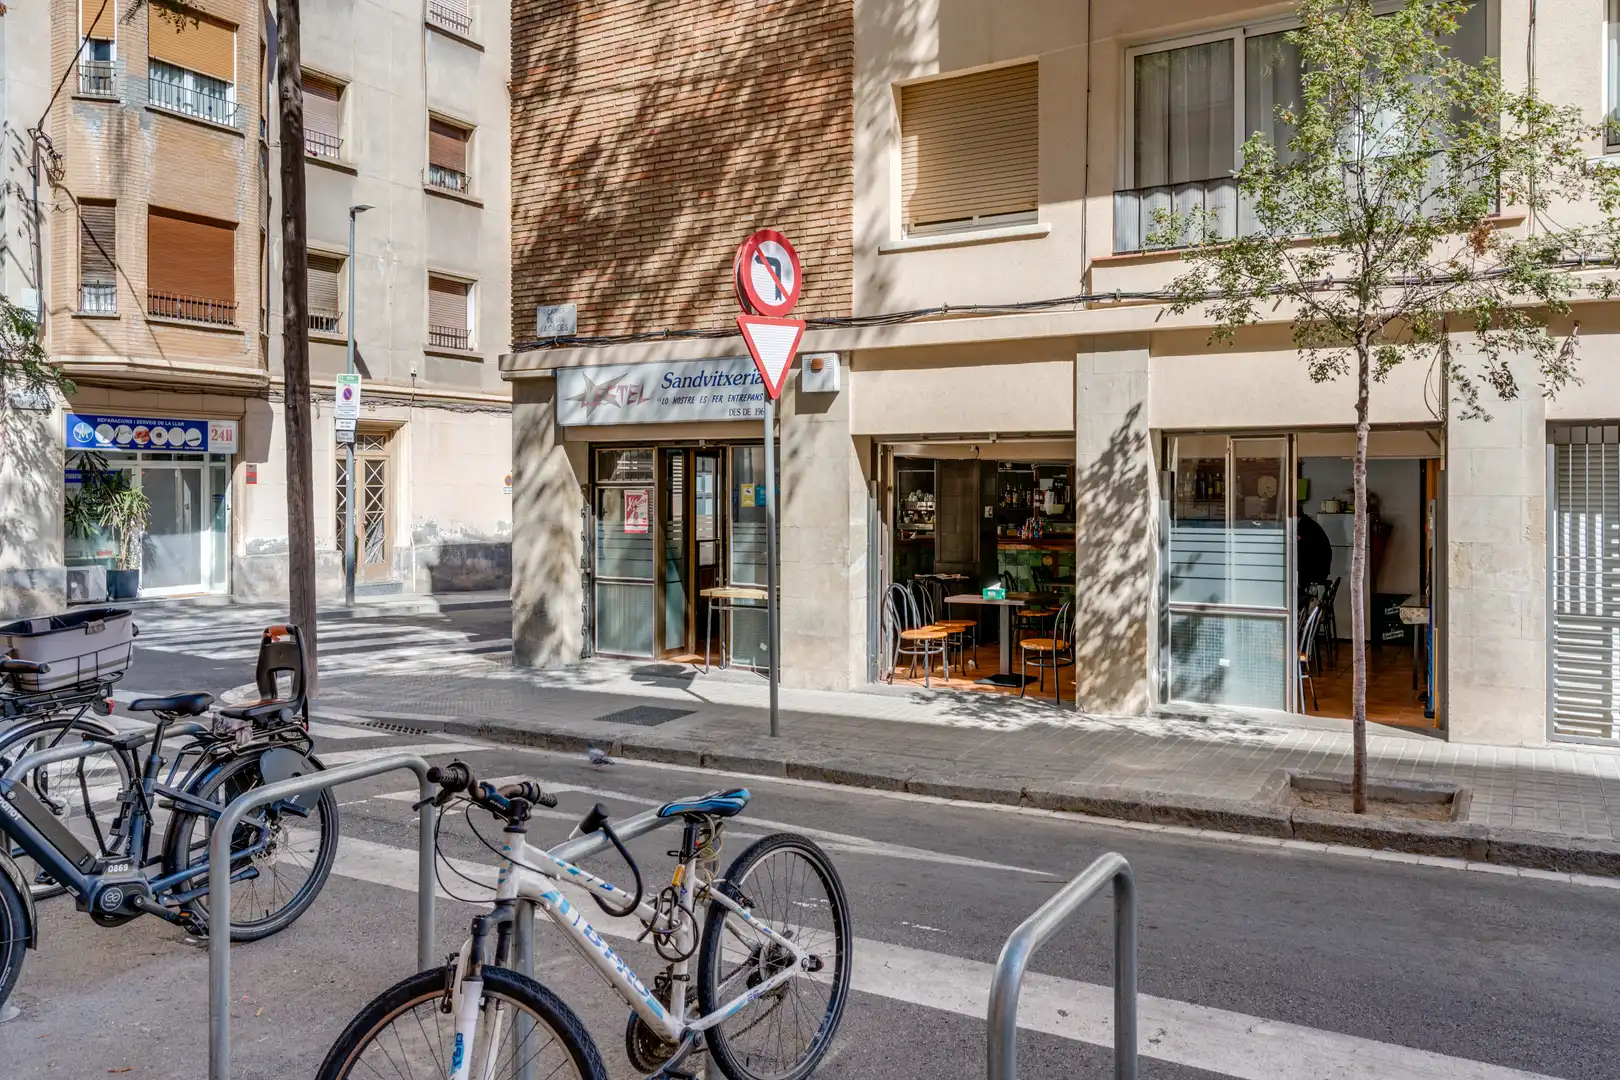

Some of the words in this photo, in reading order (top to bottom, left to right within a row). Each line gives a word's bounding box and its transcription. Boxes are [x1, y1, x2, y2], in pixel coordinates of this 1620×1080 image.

[661, 369, 764, 389] Sandvitxeria
[672, 396, 695, 405] NOSTRE
[699, 396, 707, 404] ES
[711, 394, 724, 403] FER
[107, 863, 129, 873] 0869
